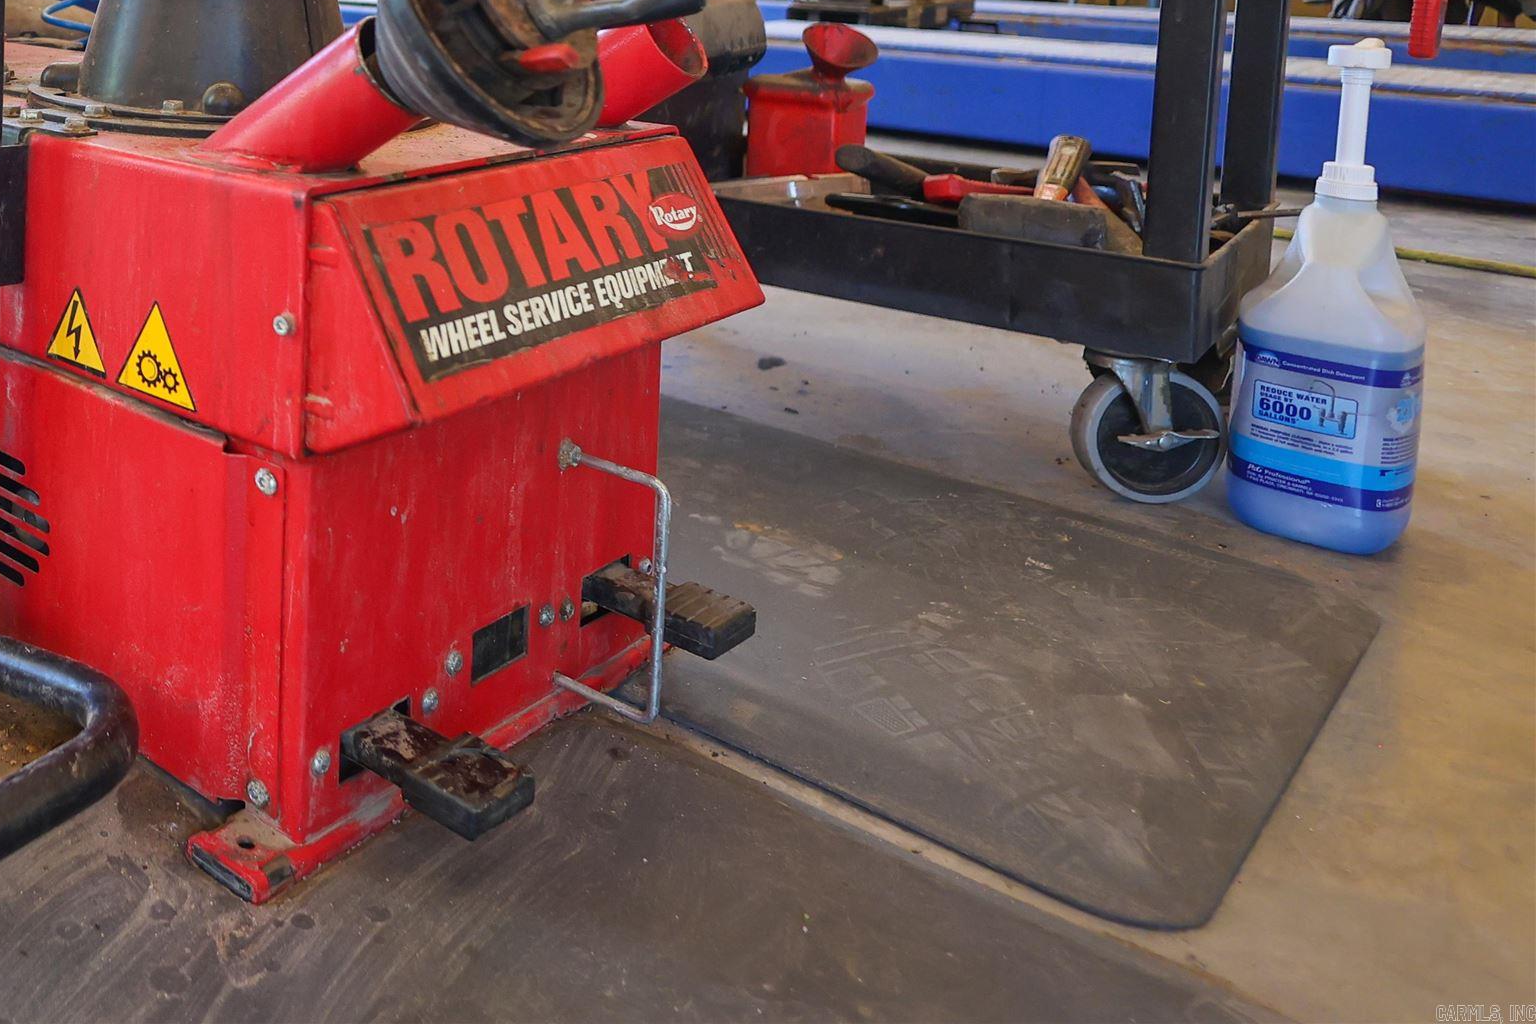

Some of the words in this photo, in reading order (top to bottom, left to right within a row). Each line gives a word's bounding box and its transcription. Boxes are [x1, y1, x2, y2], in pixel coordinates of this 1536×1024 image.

[649, 205, 697, 231] Rotary
[368, 172, 670, 324] ROTARY
[419, 308, 507, 362] WHEEL
[505, 282, 594, 336] SERVICE
[1260, 385, 1294, 398] REDUCE
[1296, 393, 1327, 405] WATER
[1260, 392, 1282, 401] USAGE
[1259, 397, 1312, 420] 6000
